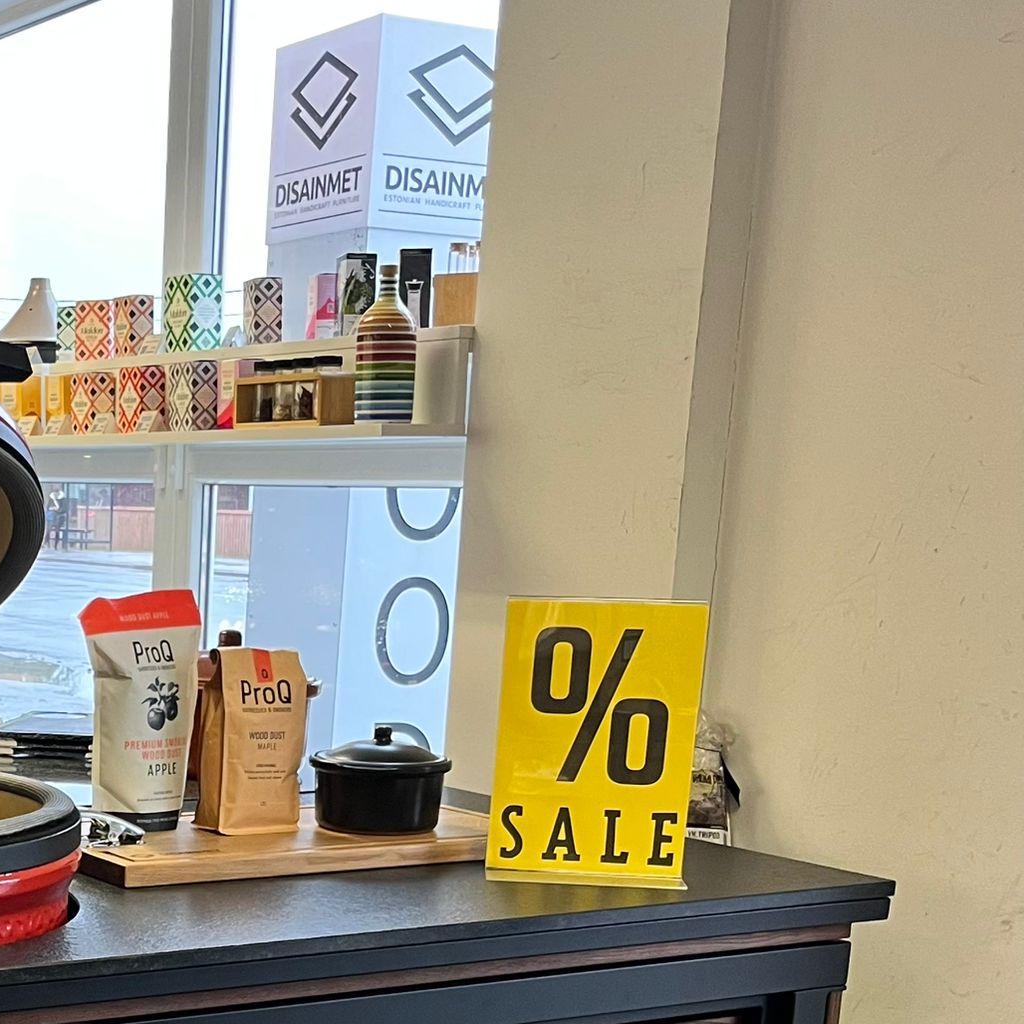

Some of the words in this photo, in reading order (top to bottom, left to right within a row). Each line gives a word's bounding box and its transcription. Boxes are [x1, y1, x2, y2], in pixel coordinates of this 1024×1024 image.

[275, 165, 362, 208] DISAINMET
[383, 194, 421, 204] ESTONIAN
[424, 198, 471, 210] HANDICRAFT
[132, 639, 174, 665] ProQ
[240, 679, 292, 705] ProQ
[249, 731, 268, 740] WOOD
[269, 731, 286, 740] DUST
[124, 739, 163, 750] PREMIUM
[257, 742, 277, 751] MAPLE
[142, 750, 164, 760] WOOD
[147, 762, 177, 777] APPLE
[499, 804, 679, 867] SALE
